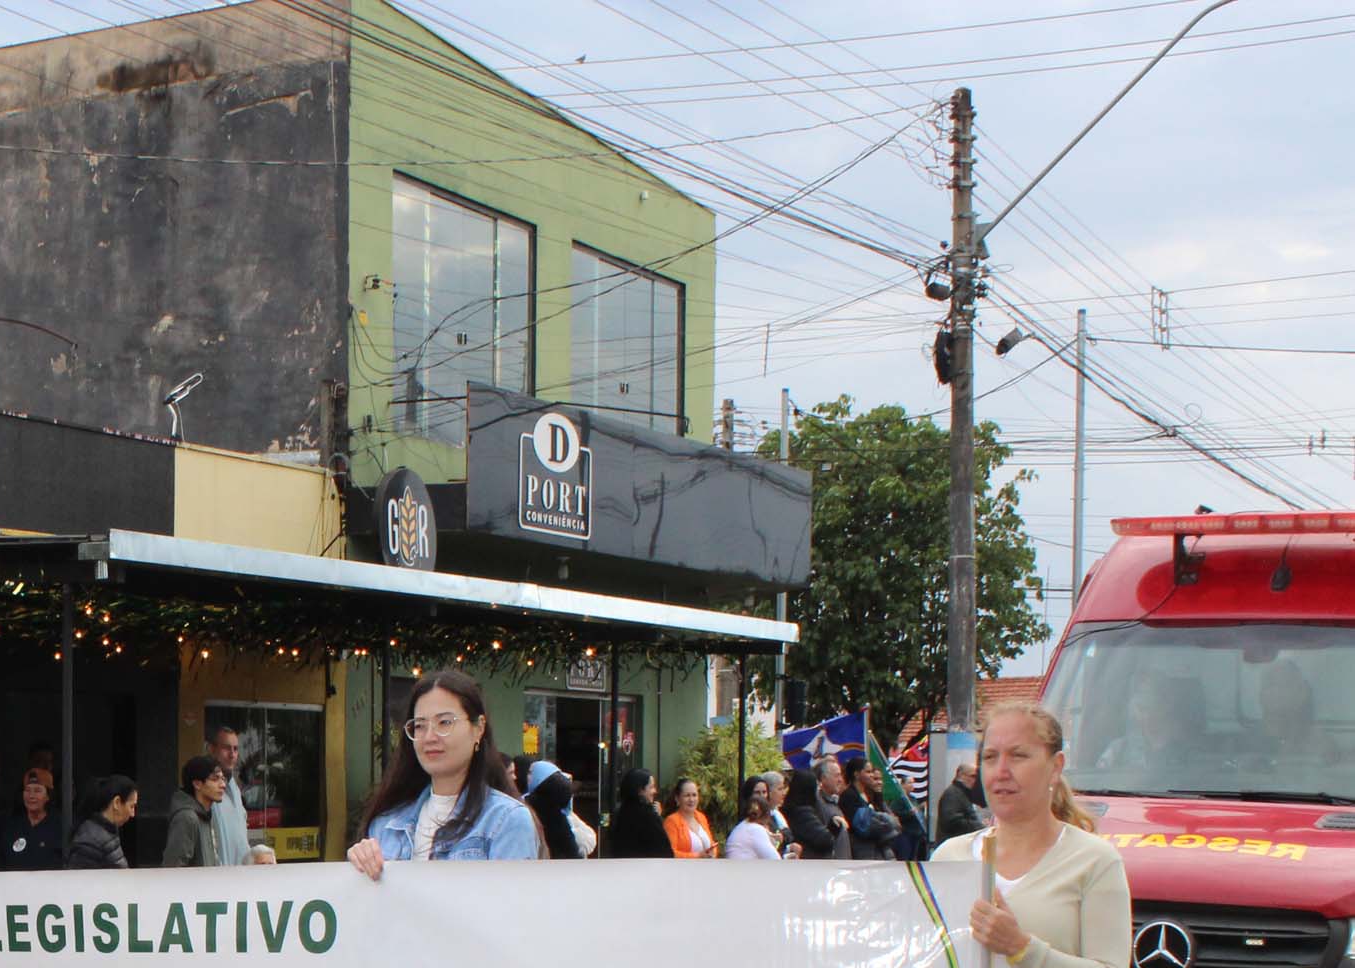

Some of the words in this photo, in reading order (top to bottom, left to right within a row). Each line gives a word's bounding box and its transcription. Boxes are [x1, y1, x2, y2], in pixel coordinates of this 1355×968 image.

[548, 423, 570, 464] D
[526, 474, 586, 517] PORT
[526, 510, 586, 531] CONVENIÊNCIA
